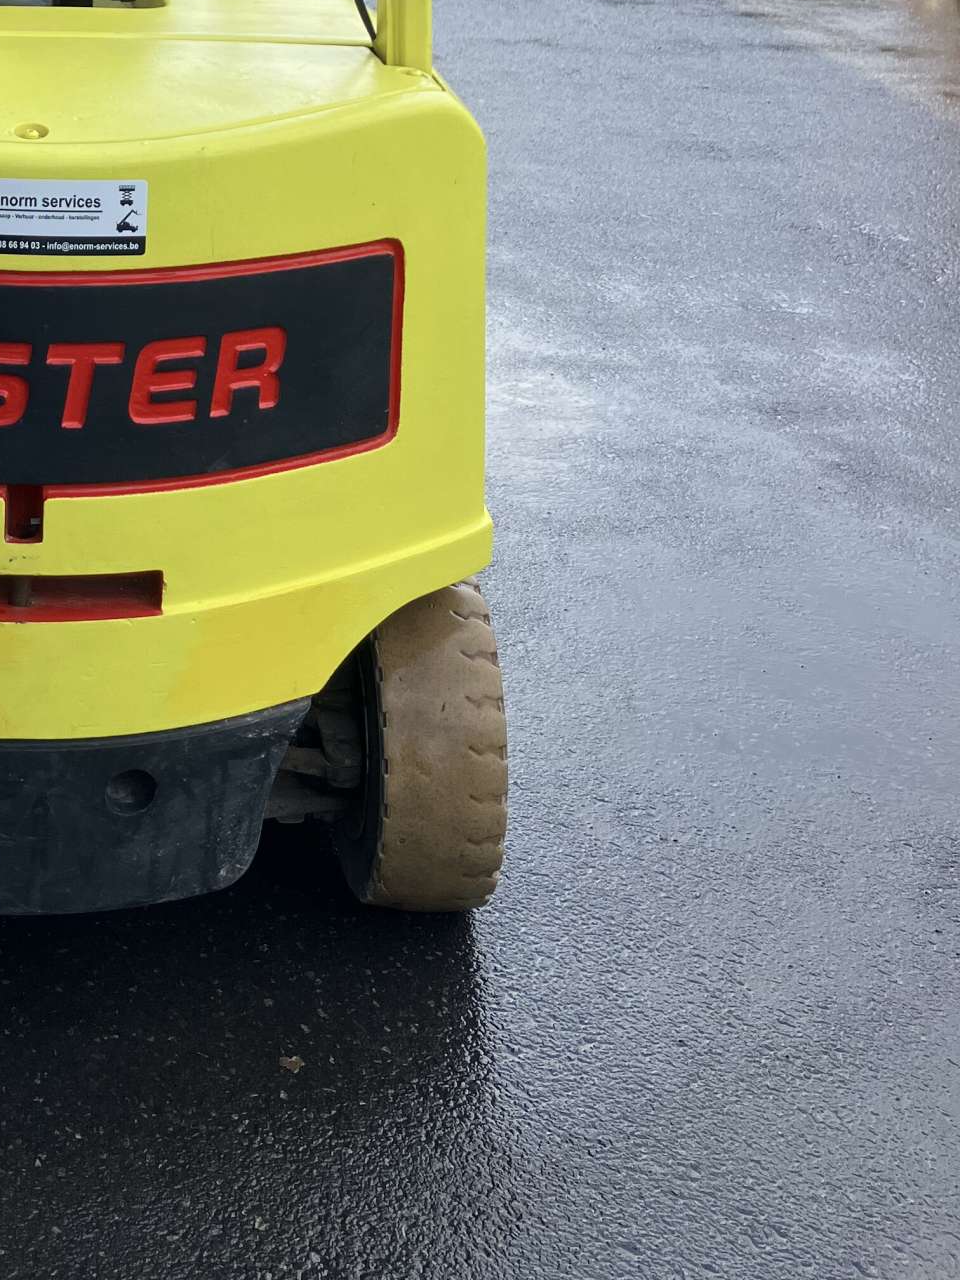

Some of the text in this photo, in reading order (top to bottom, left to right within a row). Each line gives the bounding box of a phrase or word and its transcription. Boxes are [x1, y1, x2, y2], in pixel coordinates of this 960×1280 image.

[42, 195, 101, 208] services
[8, 240, 18, 249] 66
[19, 240, 29, 249] 94
[30, 241, 40, 249] 03
[47, 241, 139, 252] info@enorm-services.be
